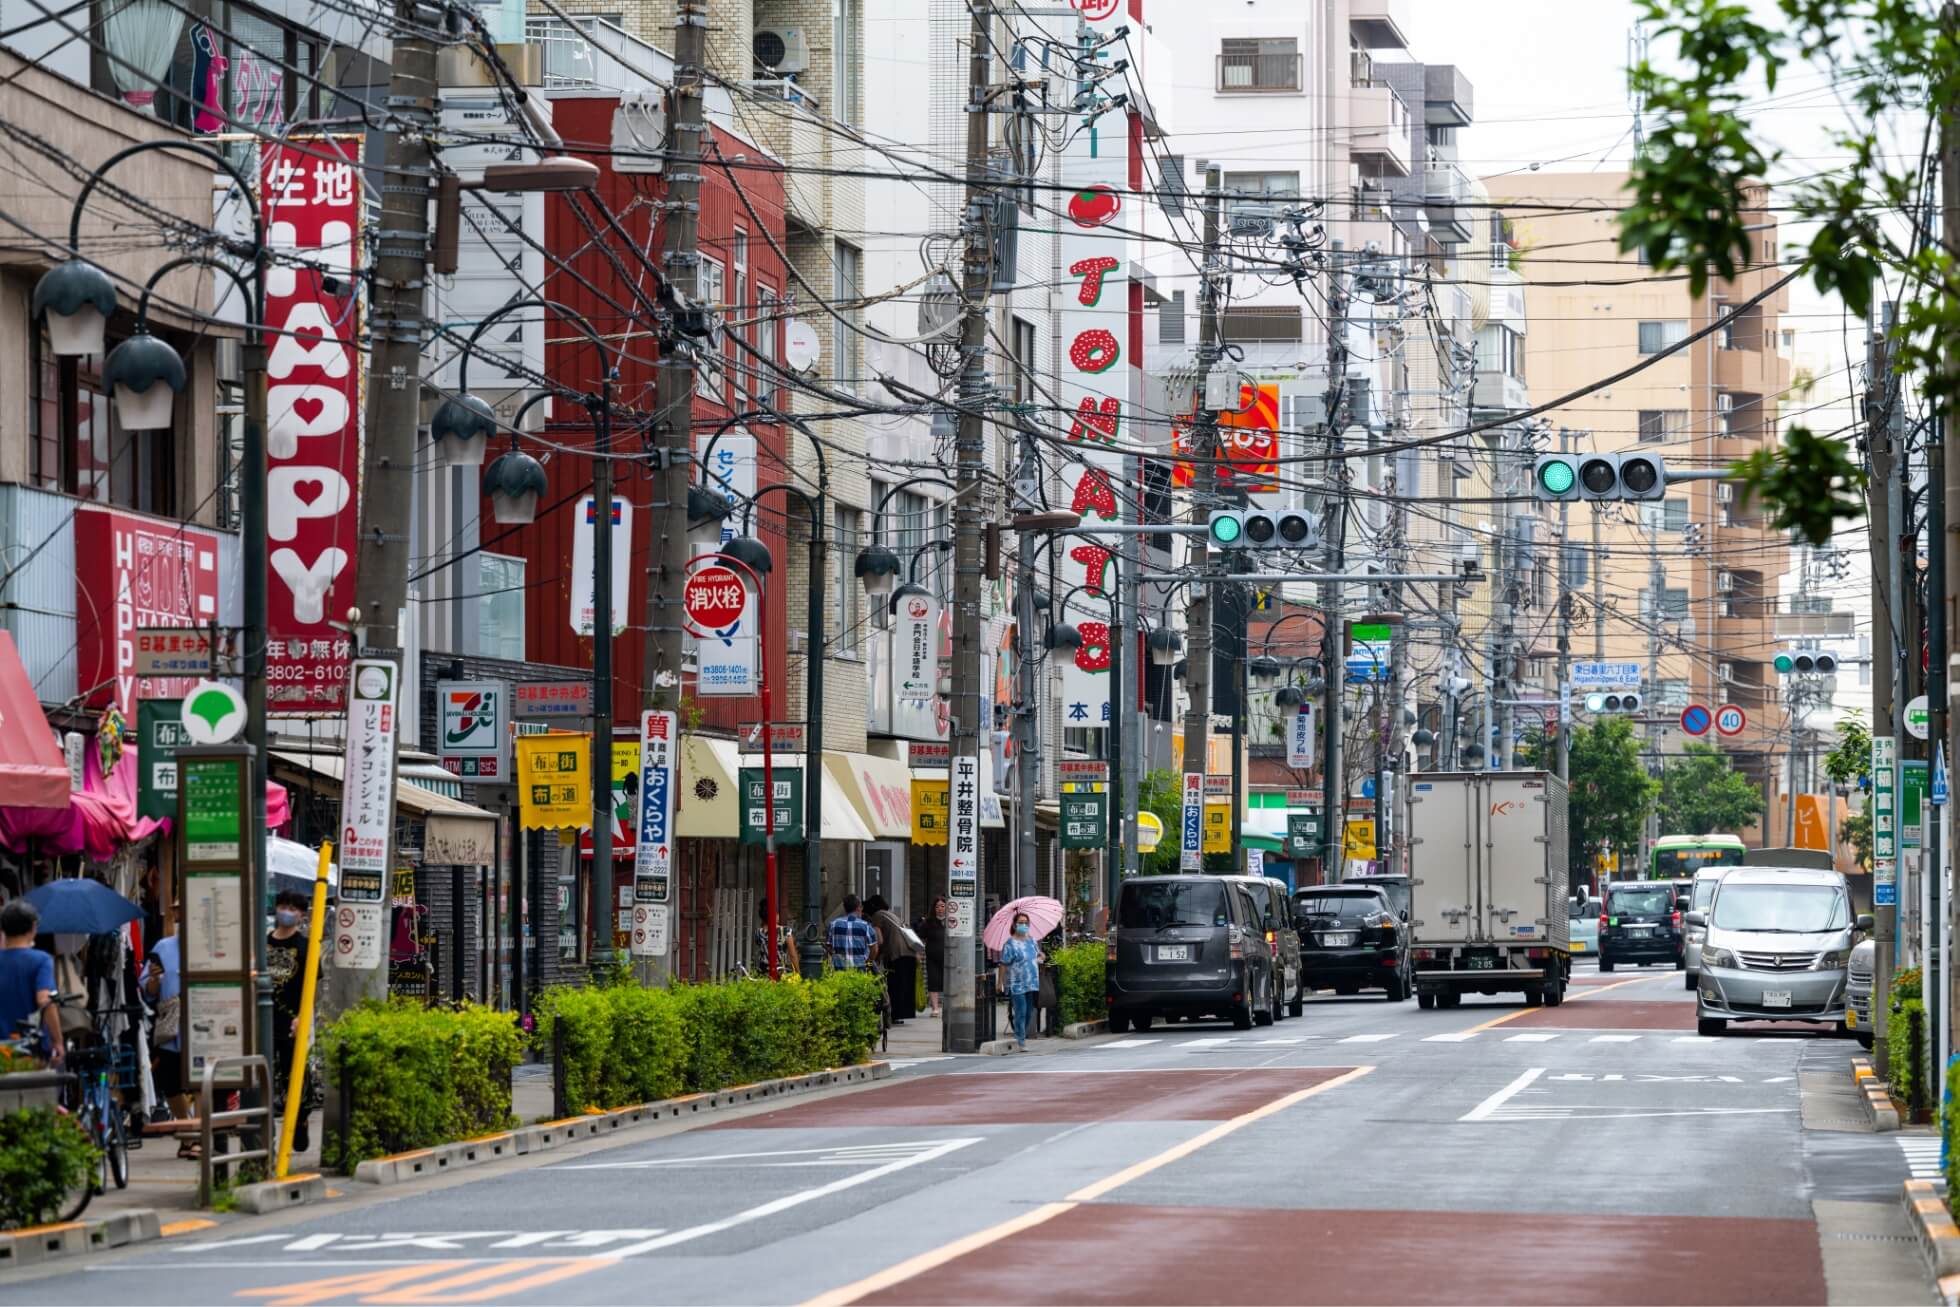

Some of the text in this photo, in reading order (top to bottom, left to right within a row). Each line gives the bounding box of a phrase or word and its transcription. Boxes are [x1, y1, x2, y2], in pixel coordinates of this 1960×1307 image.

[266, 159, 353, 206] 生地
[266, 221, 352, 624] HAPPY
[689, 584, 741, 612] 消火栓
[116, 530, 134, 714] HAPPY
[647, 715, 669, 740] 質
[1722, 713, 1739, 728] 40
[444, 759, 460, 775] ATM
[644, 769, 665, 841] おくらや
[751, 810, 789, 824] 布道
[957, 763, 974, 853] 平井整骨院
[1186, 807, 1199, 848] おくらや
